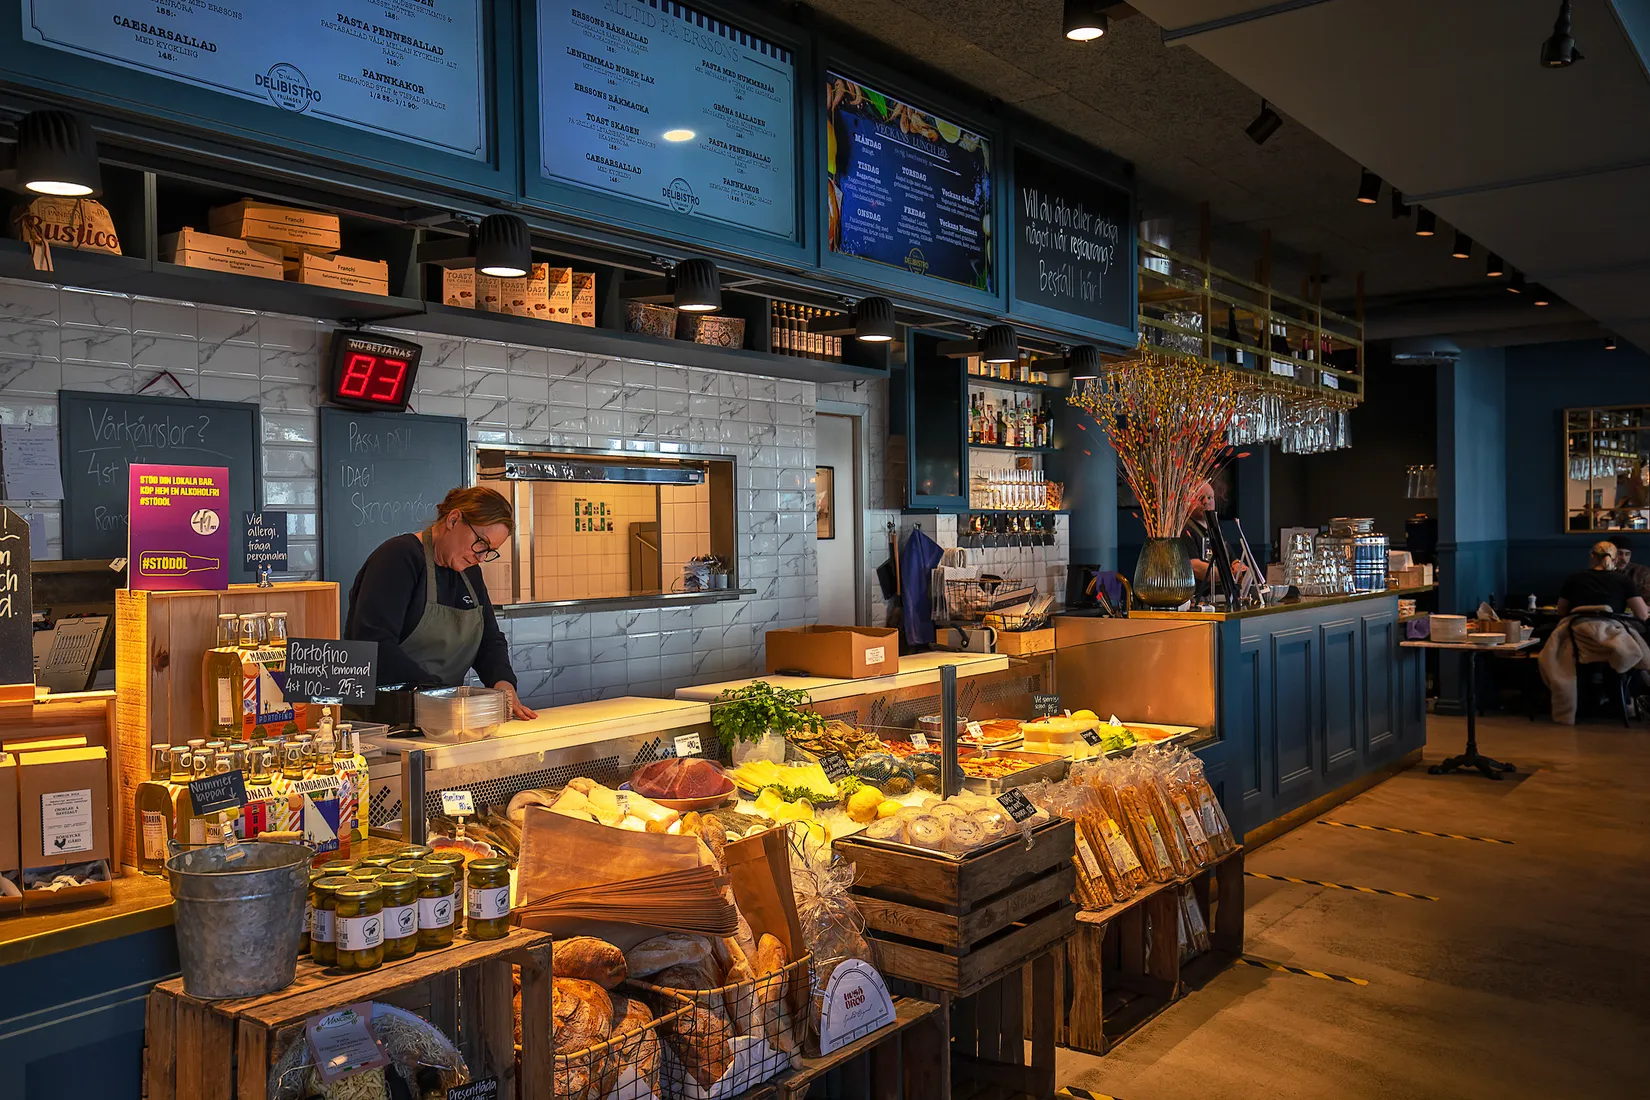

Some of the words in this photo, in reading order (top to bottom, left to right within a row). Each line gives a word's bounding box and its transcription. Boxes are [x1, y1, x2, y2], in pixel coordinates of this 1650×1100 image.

[208, 4, 243, 20] ERSSONS
[571, 8, 605, 28] ERSSONS
[113, 14, 217, 53] CAESARSALLAD
[337, 13, 370, 32] PASTA
[372, 25, 444, 56] PENNESALLAD
[603, 0, 657, 28] ALLTID
[660, 17, 679, 39] PÅ
[680, 26, 739, 63] ERSSONS
[135, 34, 154, 46] MED
[156, 41, 198, 58] KYCKLING
[362, 68, 425, 95] PANNKAKOR
[615, 63, 639, 80] NORSK
[640, 73, 655, 85] LAX
[255, 73, 322, 102] DELIBISTRO
[574, 82, 607, 100] ERSSONS
[586, 112, 610, 126] TOAST
[611, 118, 640, 136] SKAGEN
[854, 132, 882, 151] MÅNDAG
[875, 122, 910, 145] VECKANS
[708, 137, 728, 150] PASTA
[585, 152, 642, 175] CAESARSALLAD
[857, 160, 880, 176] TISDAG
[901, 166, 927, 182] TORSDAG
[723, 178, 760, 195] PANNKAKOR
[662, 187, 700, 206] DELIBISTRO
[857, 208, 882, 223] ONSDAG
[903, 205, 926, 219] FREDAG
[1023, 187, 1039, 219] Vill
[1040, 194, 1053, 224] du
[1073, 202, 1093, 233] eller
[285, 215, 305, 225] Franchi
[24, 215, 119, 250] Rustico
[226, 246, 248, 257] Franchi
[337, 264, 356, 273] Franchi
[446, 271, 473, 280] TOAST
[477, 277, 498, 286] OAST
[1039, 259, 1075, 298] Beställ
[527, 286, 547, 294] OAST
[551, 290, 570, 298] OAST
[574, 294, 594, 303] OAST
[350, 341, 365, 350] NU
[340, 354, 408, 401] 83
[349, 421, 381, 454] PASSA
[139, 475, 159, 485] STÖD
[159, 476, 172, 486] DIN
[172, 476, 198, 486] LOKALA
[198, 477, 215, 487] BAR.
[139, 485, 154, 495] KÖP
[154, 486, 170, 496] HEM
[170, 487, 179, 496] EN
[179, 487, 220, 497] ALKOHOLFRI
[139, 496, 171, 507] #STÖDÖL
[246, 512, 263, 526] Vid
[247, 522, 280, 540] allergi,
[248, 539, 271, 552] fråga
[142, 556, 188, 571] #STÖDÖL
[246, 550, 287, 563] personalen
[250, 649, 286, 662] MANDARINA
[290, 641, 348, 665] Portofino
[331, 661, 371, 677] lemonad
[304, 680, 331, 696] 100:-
[259, 711, 293, 723] PORTOFINO
[334, 759, 356, 770] NATA
[294, 775, 340, 793] MANDARINATA
[246, 786, 274, 801] ONATA
